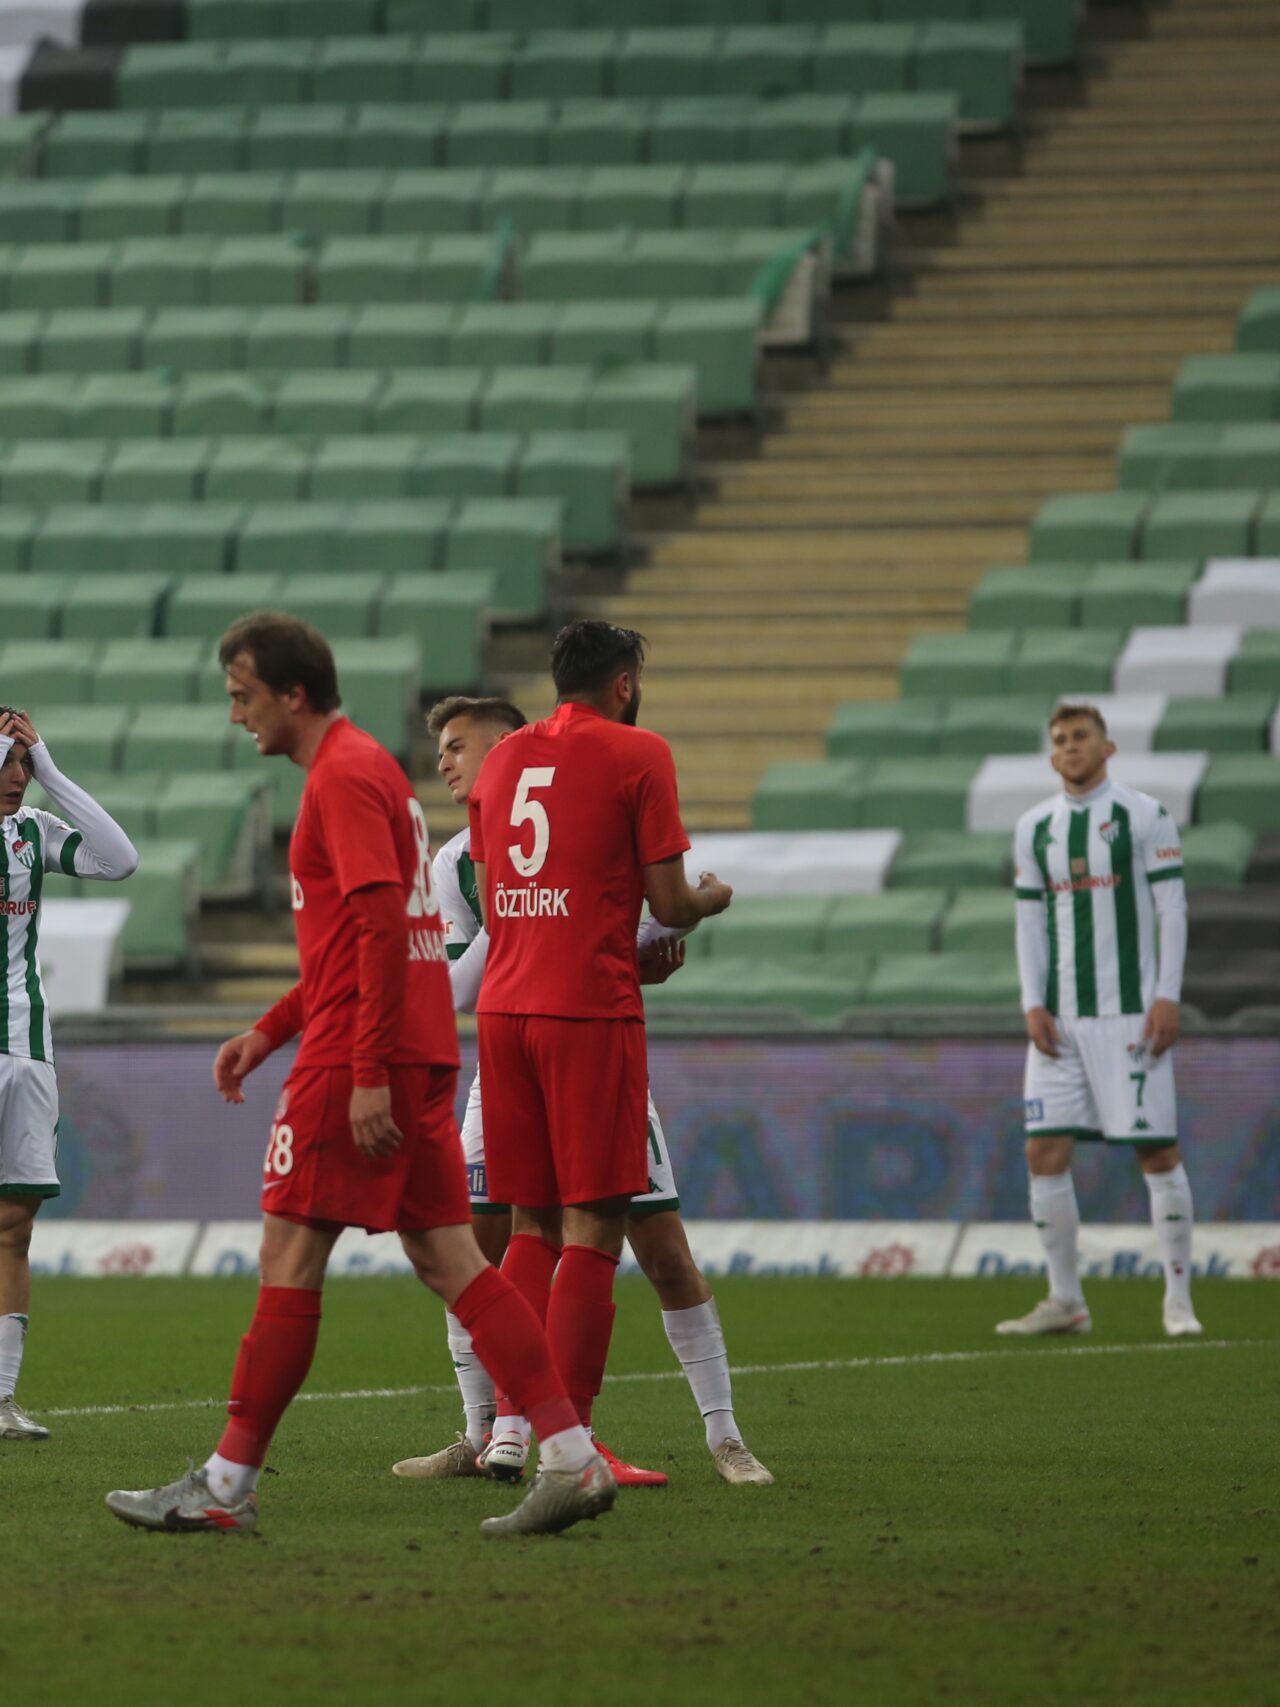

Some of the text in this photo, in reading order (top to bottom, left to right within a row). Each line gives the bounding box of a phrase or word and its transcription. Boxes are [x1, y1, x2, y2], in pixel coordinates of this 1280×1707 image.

[508, 767, 556, 877] 5
[495, 882, 570, 918] ÖZTÜRK
[1130, 1072, 1147, 1107] 7
